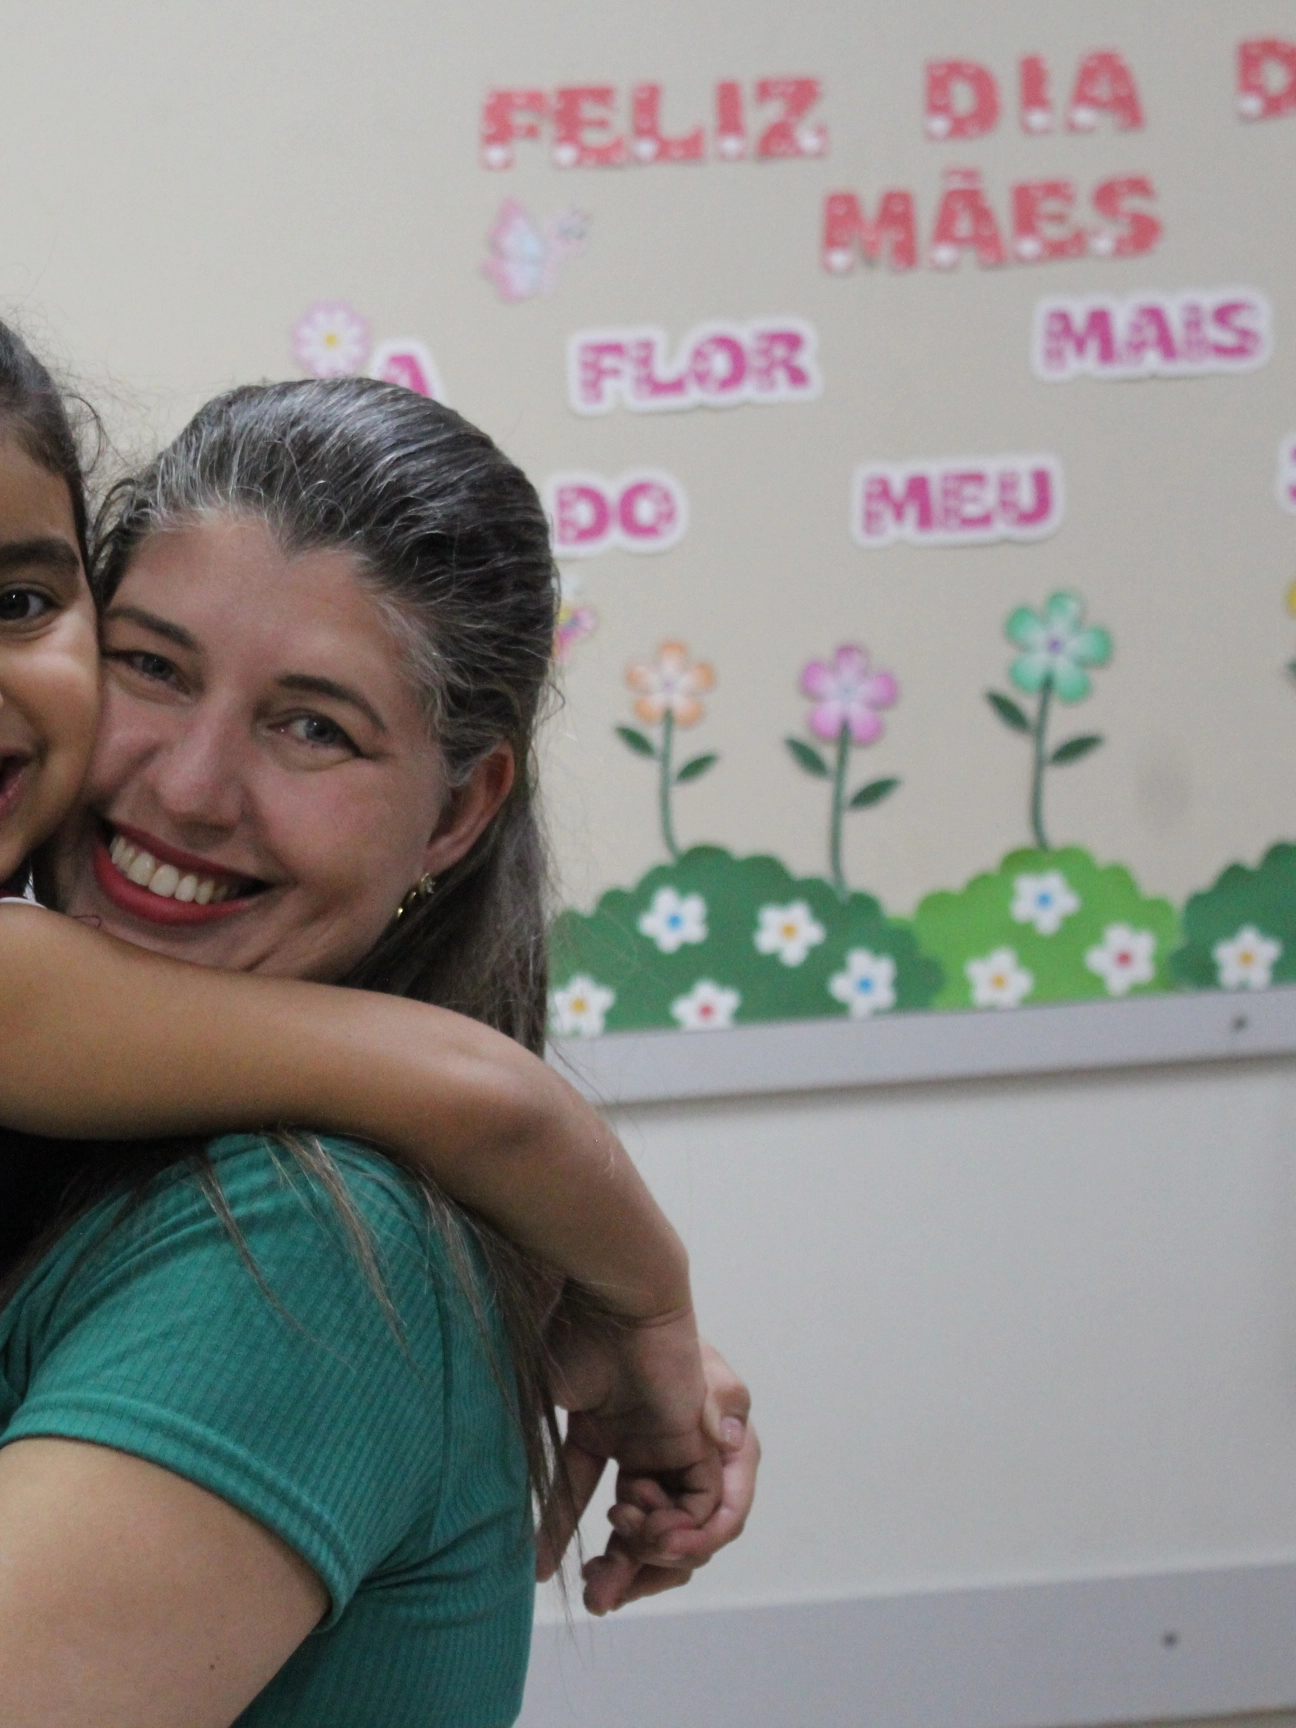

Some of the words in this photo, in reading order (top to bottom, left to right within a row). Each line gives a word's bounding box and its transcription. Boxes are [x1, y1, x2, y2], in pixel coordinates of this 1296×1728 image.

[481, 77, 826, 168] FELIZ
[925, 51, 1145, 139] DIA
[822, 168, 1163, 272] MÃES
[577, 330, 809, 403] FLOR
[1045, 301, 1260, 366] MAIS
[557, 482, 676, 545] DO
[862, 468, 1053, 536] MEU
